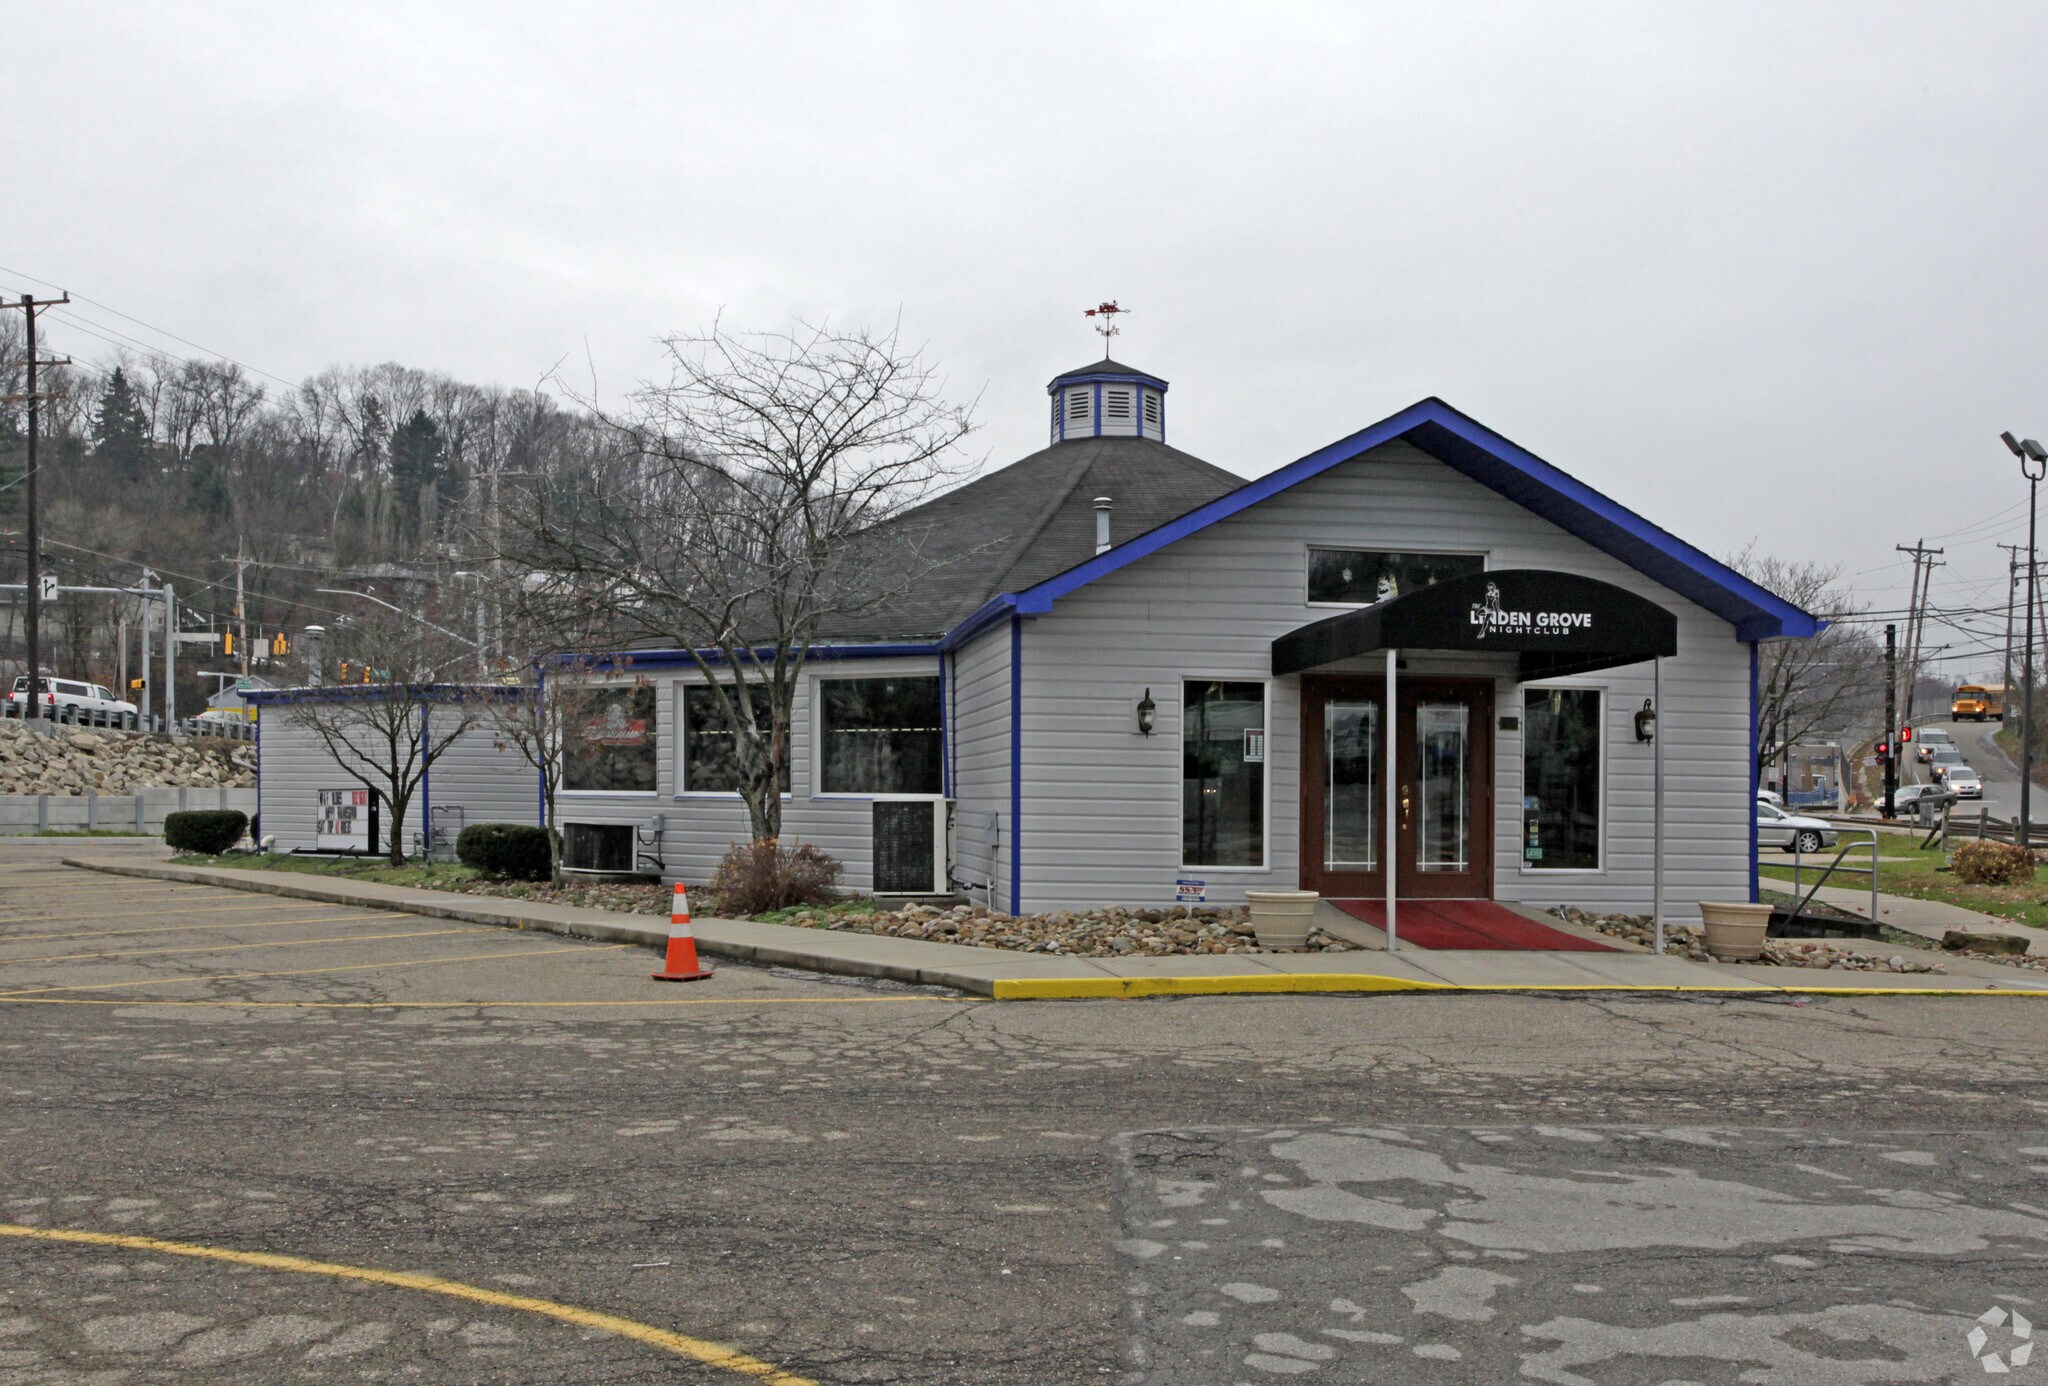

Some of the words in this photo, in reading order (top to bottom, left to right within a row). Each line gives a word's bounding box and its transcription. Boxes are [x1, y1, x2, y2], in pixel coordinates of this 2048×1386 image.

[1470, 610, 1531, 626] LINDEN
[1536, 612, 1592, 627] GROVE
[1489, 626, 1570, 635] NIGHTCLUB
